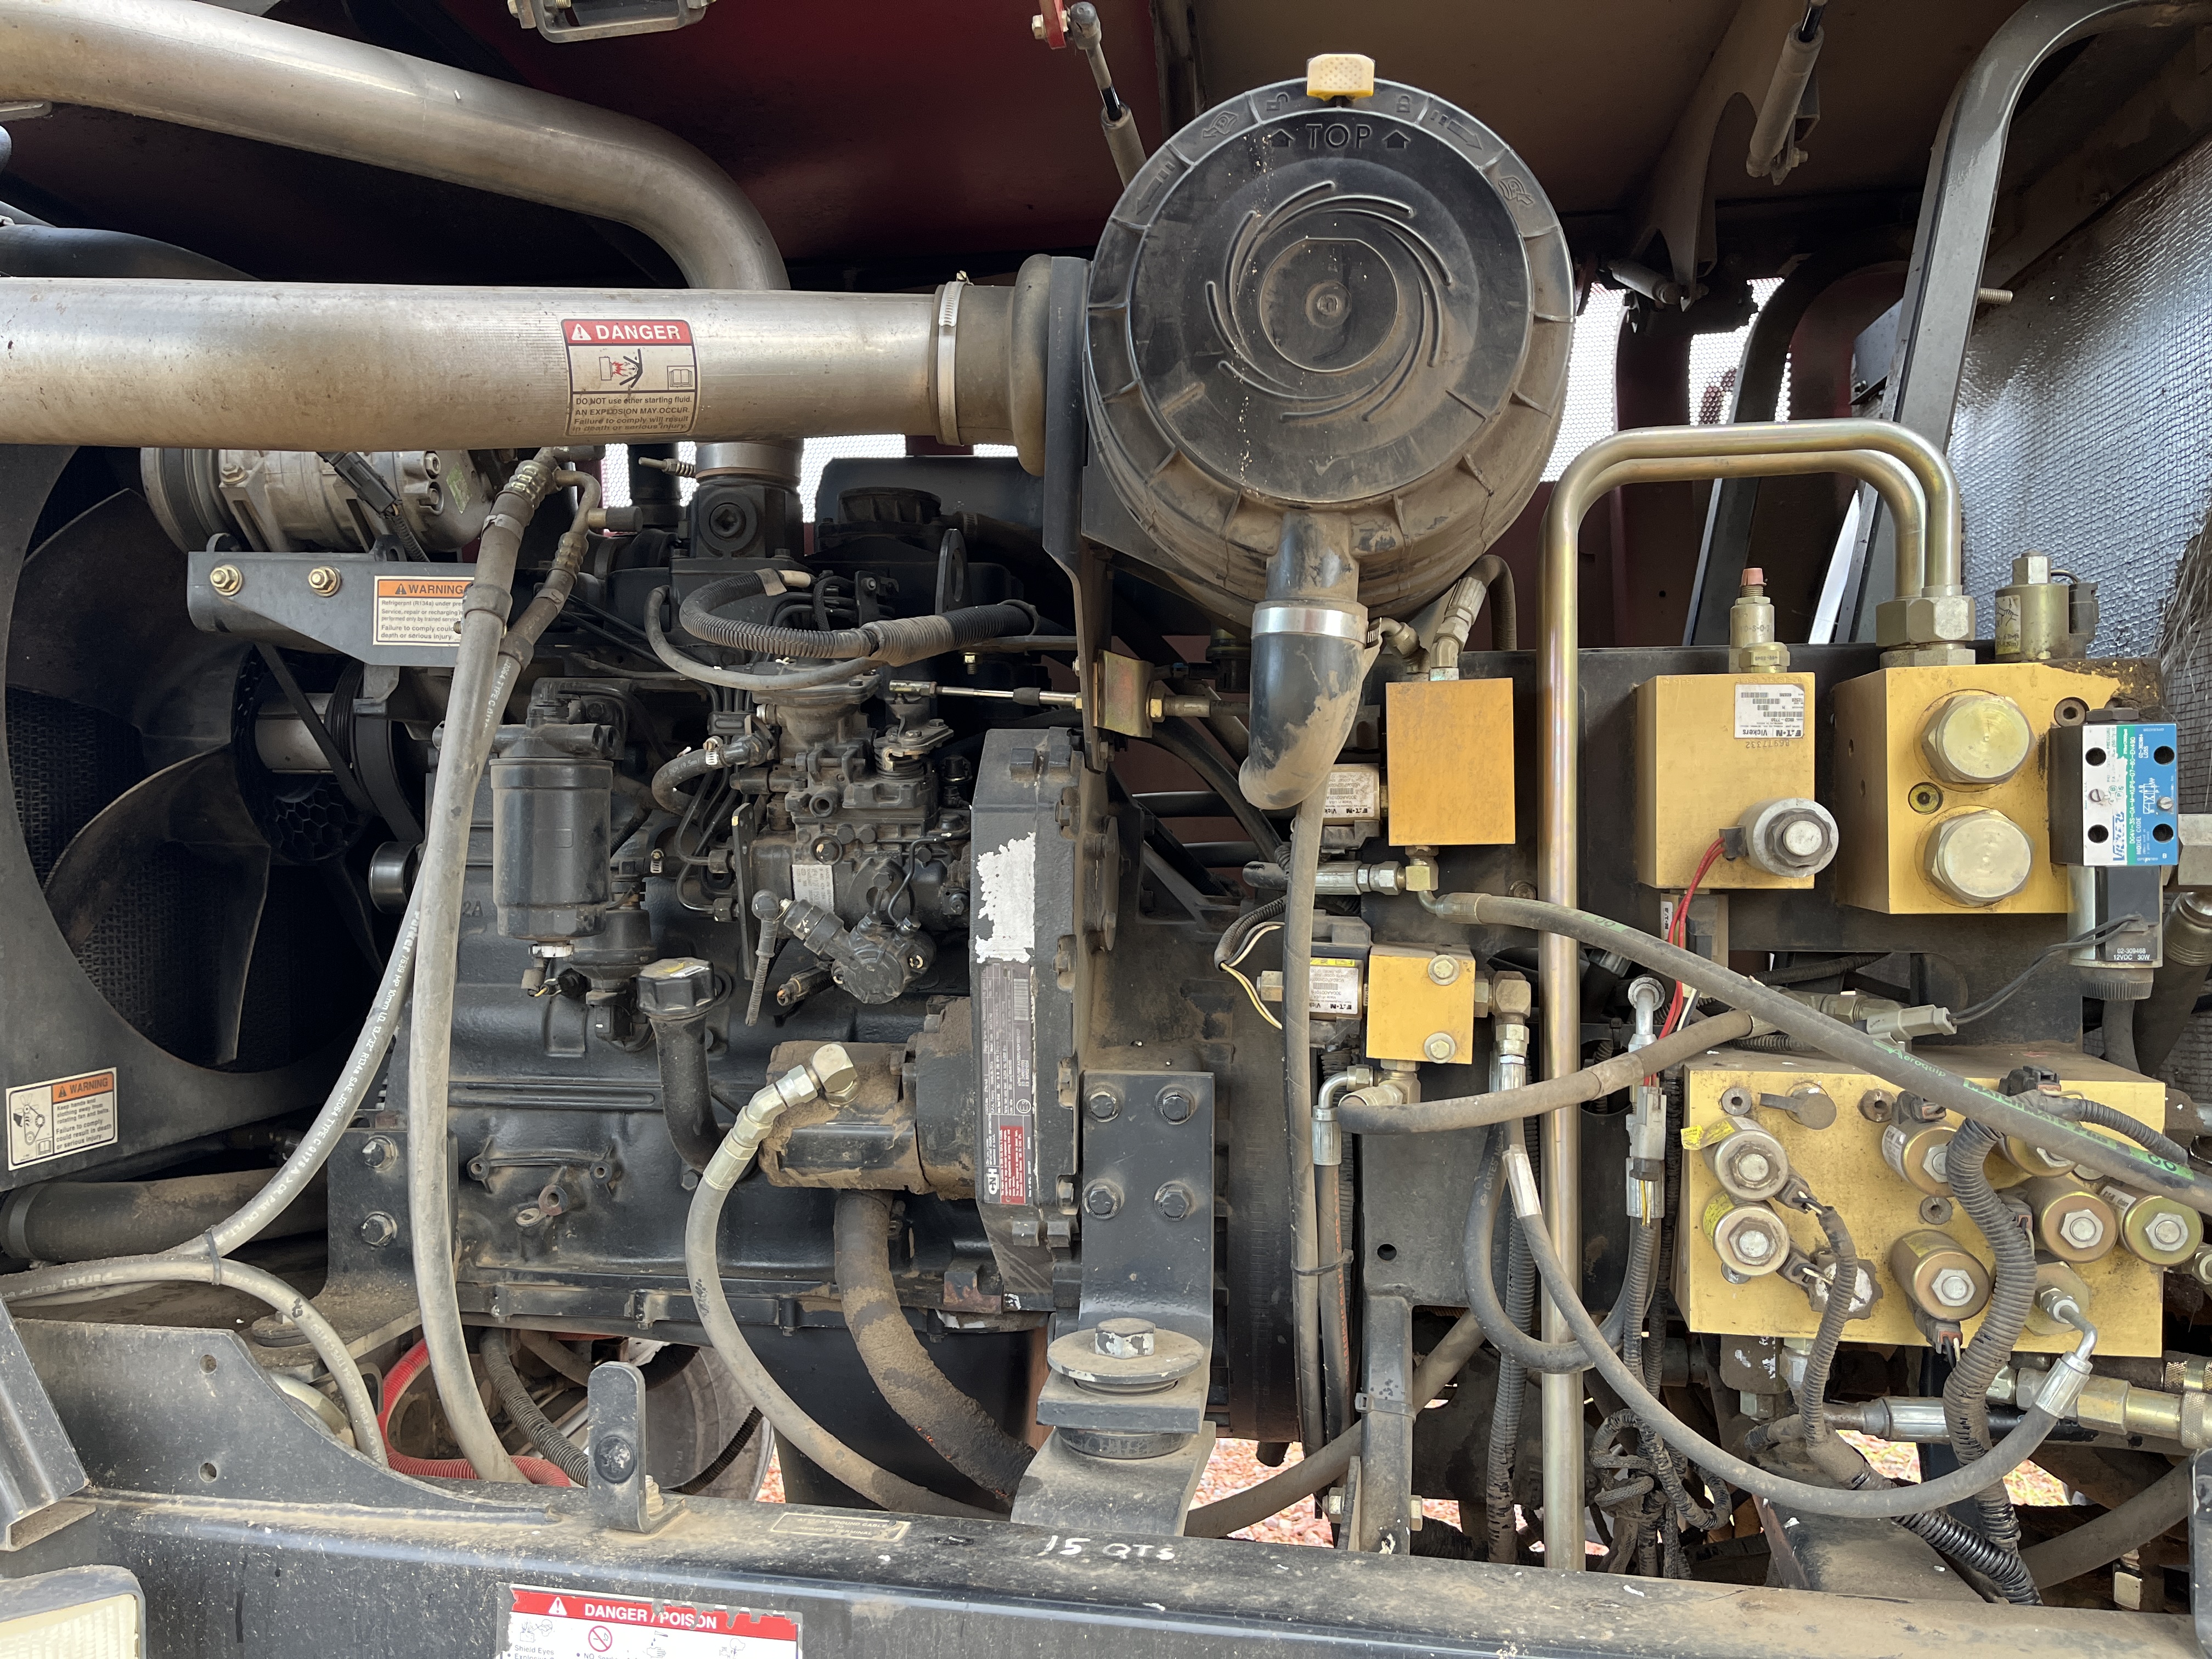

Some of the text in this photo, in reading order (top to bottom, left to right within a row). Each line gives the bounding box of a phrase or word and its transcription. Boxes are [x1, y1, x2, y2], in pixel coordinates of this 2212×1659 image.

[1306, 124, 1372, 149] TOP
[595, 325, 681, 340] DANGER
[408, 585, 464, 594] WARNING
[490, 681, 504, 700] TYPE
[403, 911, 420, 953] Parker
[397, 955, 410, 973] 7639
[393, 974, 402, 987] MP
[382, 989, 397, 1011] 10mm
[353, 1052, 370, 1074] R134a
[1894, 1048, 1946, 1076] Aeroquip
[70, 1077, 108, 1094] WARNING
[345, 1076, 358, 1093] SAE
[57, 1109, 77, 1118] clothing
[331, 1093, 347, 1117] J2064
[56, 1126, 75, 1135] Failure
[83, 1118, 103, 1129] comply
[56, 1134, 71, 1142] could
[73, 1129, 89, 1137] result
[97, 1124, 112, 1132] death
[317, 1118, 336, 1139] TYPE
[64, 1138, 84, 1149] serious
[86, 1134, 103, 1142] injury.
[987, 1169, 1000, 1195] CNH
[61, 1272, 112, 1288] Parker
[1037, 1536, 1091, 1556] 15
[584, 1602, 648, 1623] DANGER
[659, 1611, 718, 1630] POISON
[515, 1645, 555, 1655] Shield Eyes
